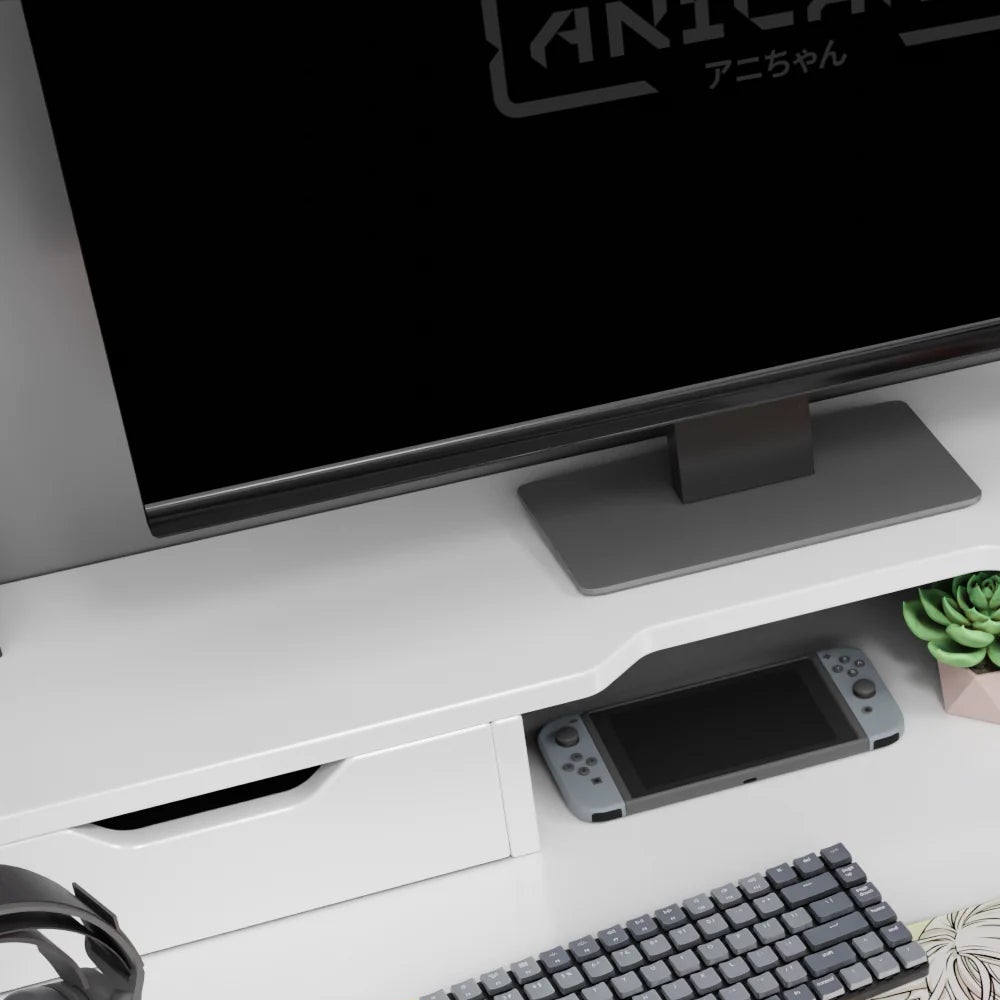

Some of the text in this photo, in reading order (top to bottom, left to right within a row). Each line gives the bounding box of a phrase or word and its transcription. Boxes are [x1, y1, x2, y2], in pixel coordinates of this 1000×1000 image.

[704, 40, 848, 89] アニちゃん
